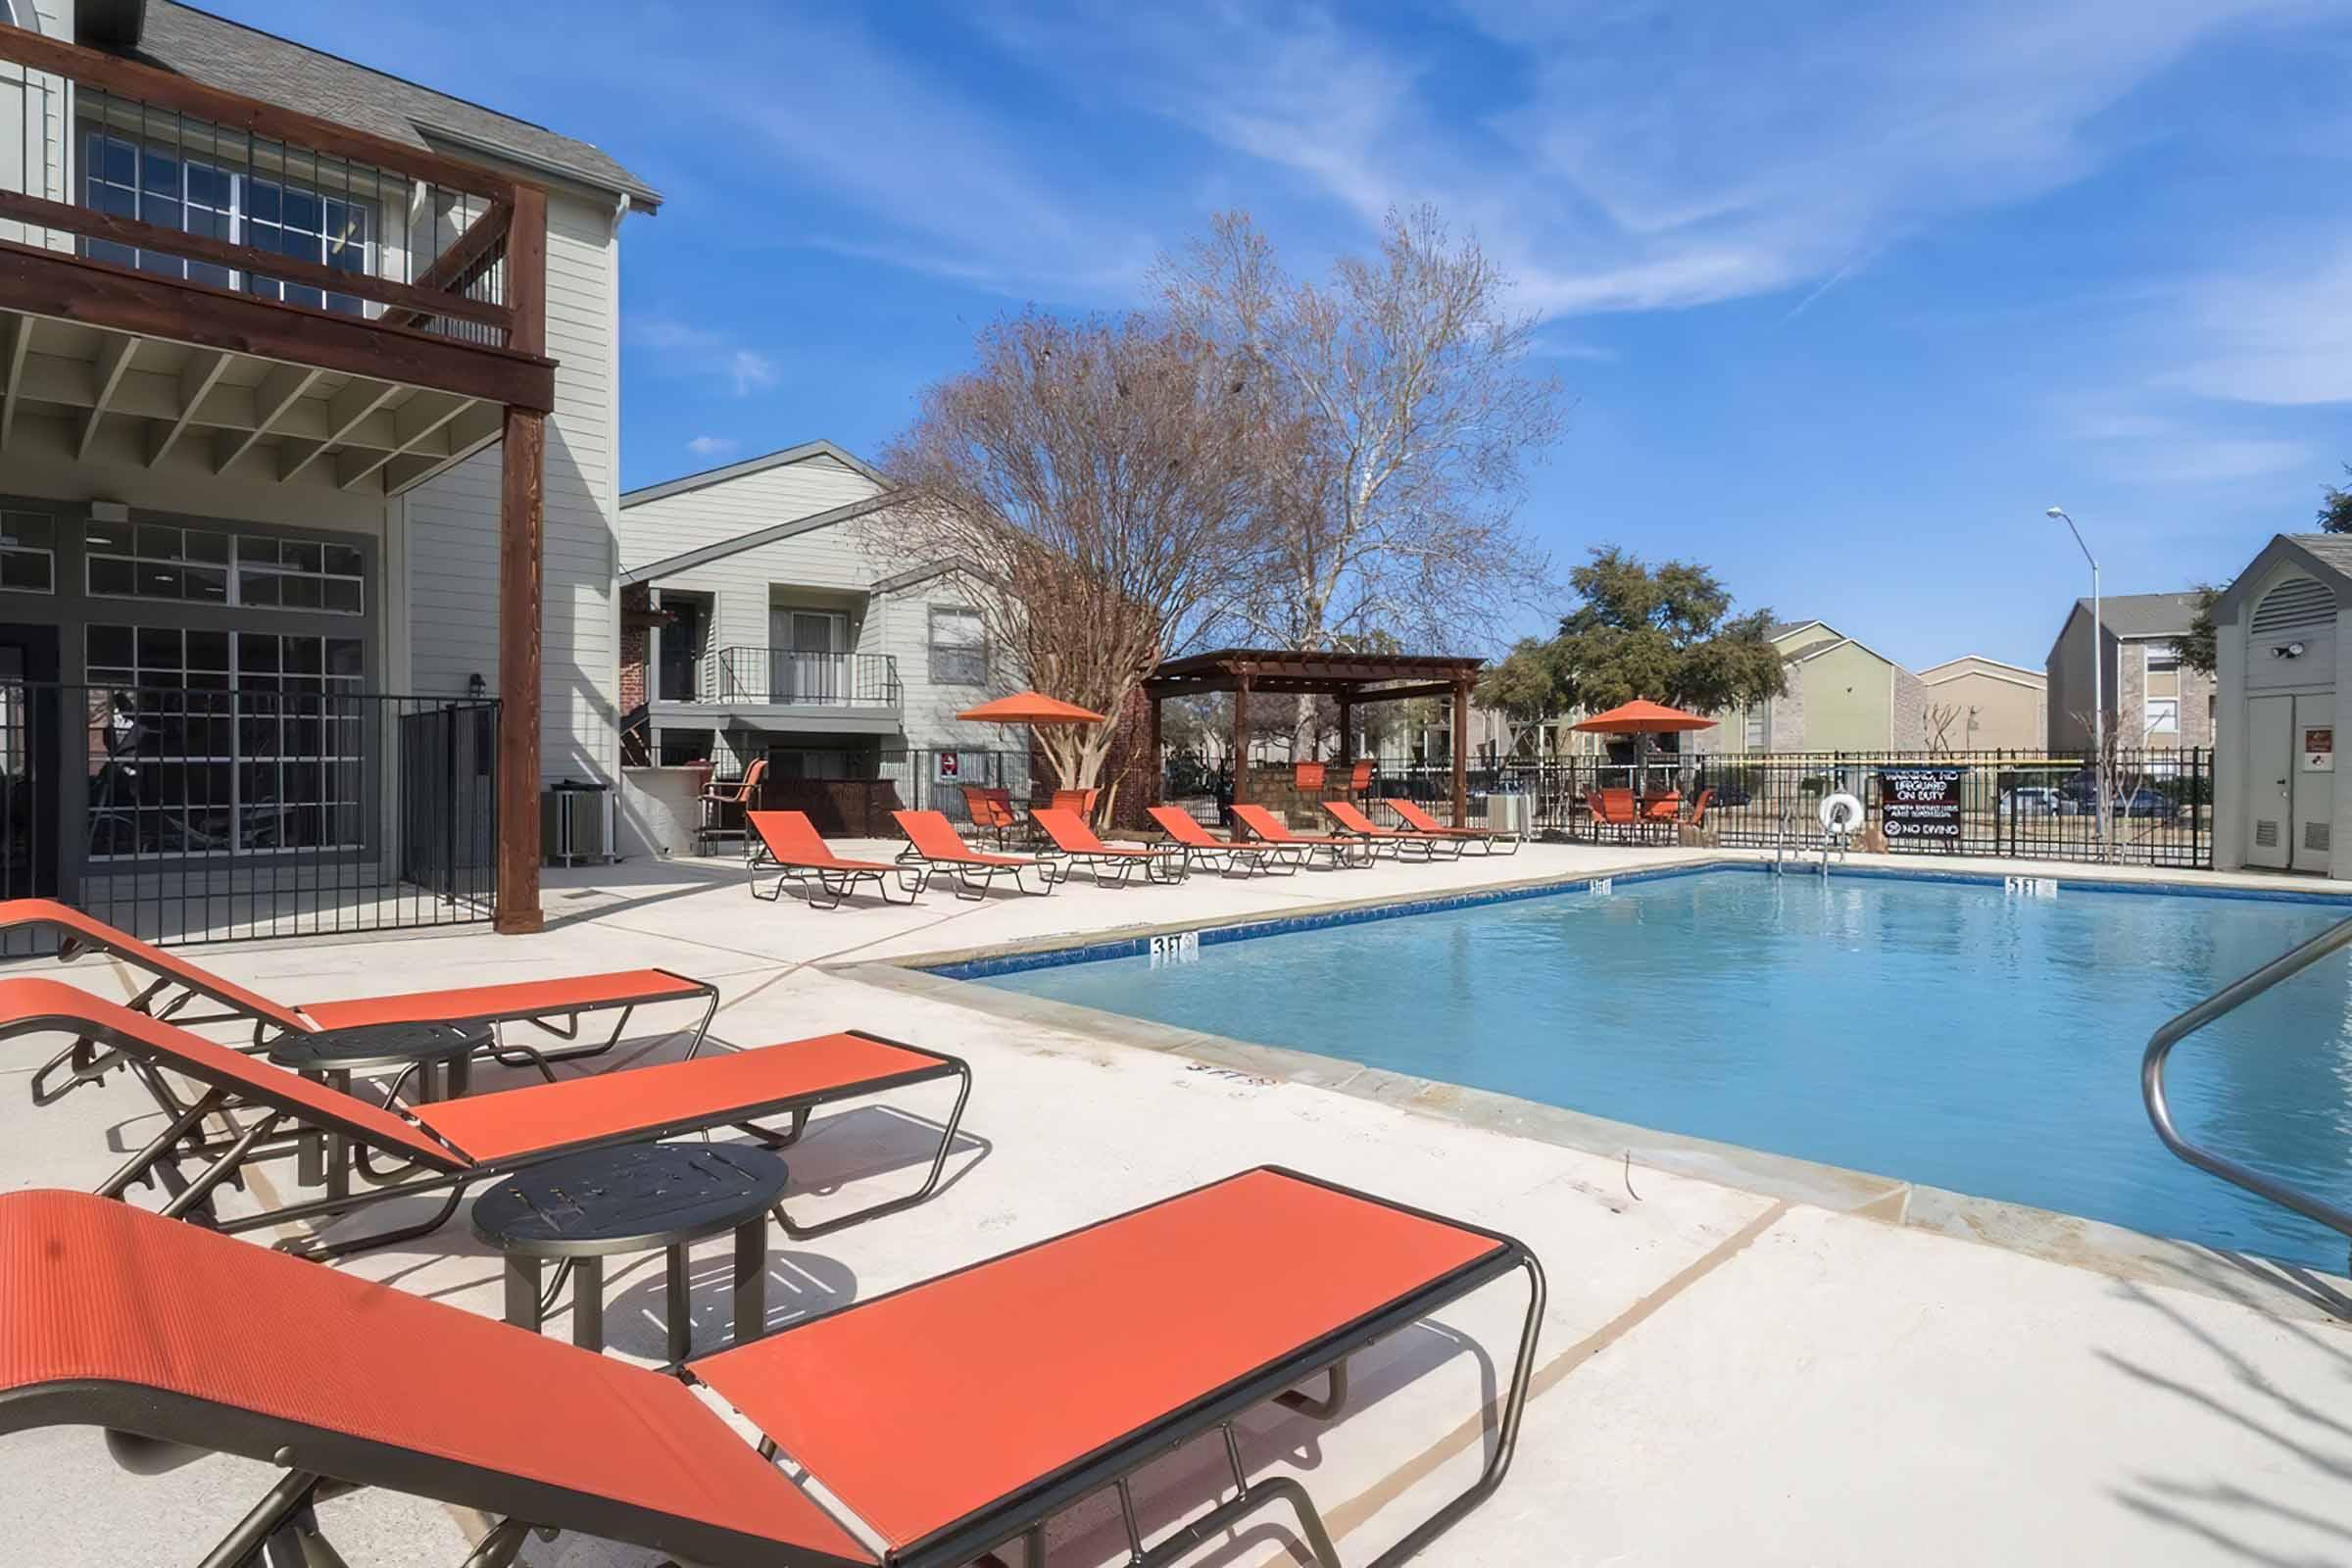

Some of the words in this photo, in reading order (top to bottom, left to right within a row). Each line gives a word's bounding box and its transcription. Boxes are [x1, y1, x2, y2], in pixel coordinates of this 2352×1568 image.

[1897, 791, 1915, 800] ON
[1918, 791, 1945, 800] DUTY
[1903, 824, 1921, 834] NO
